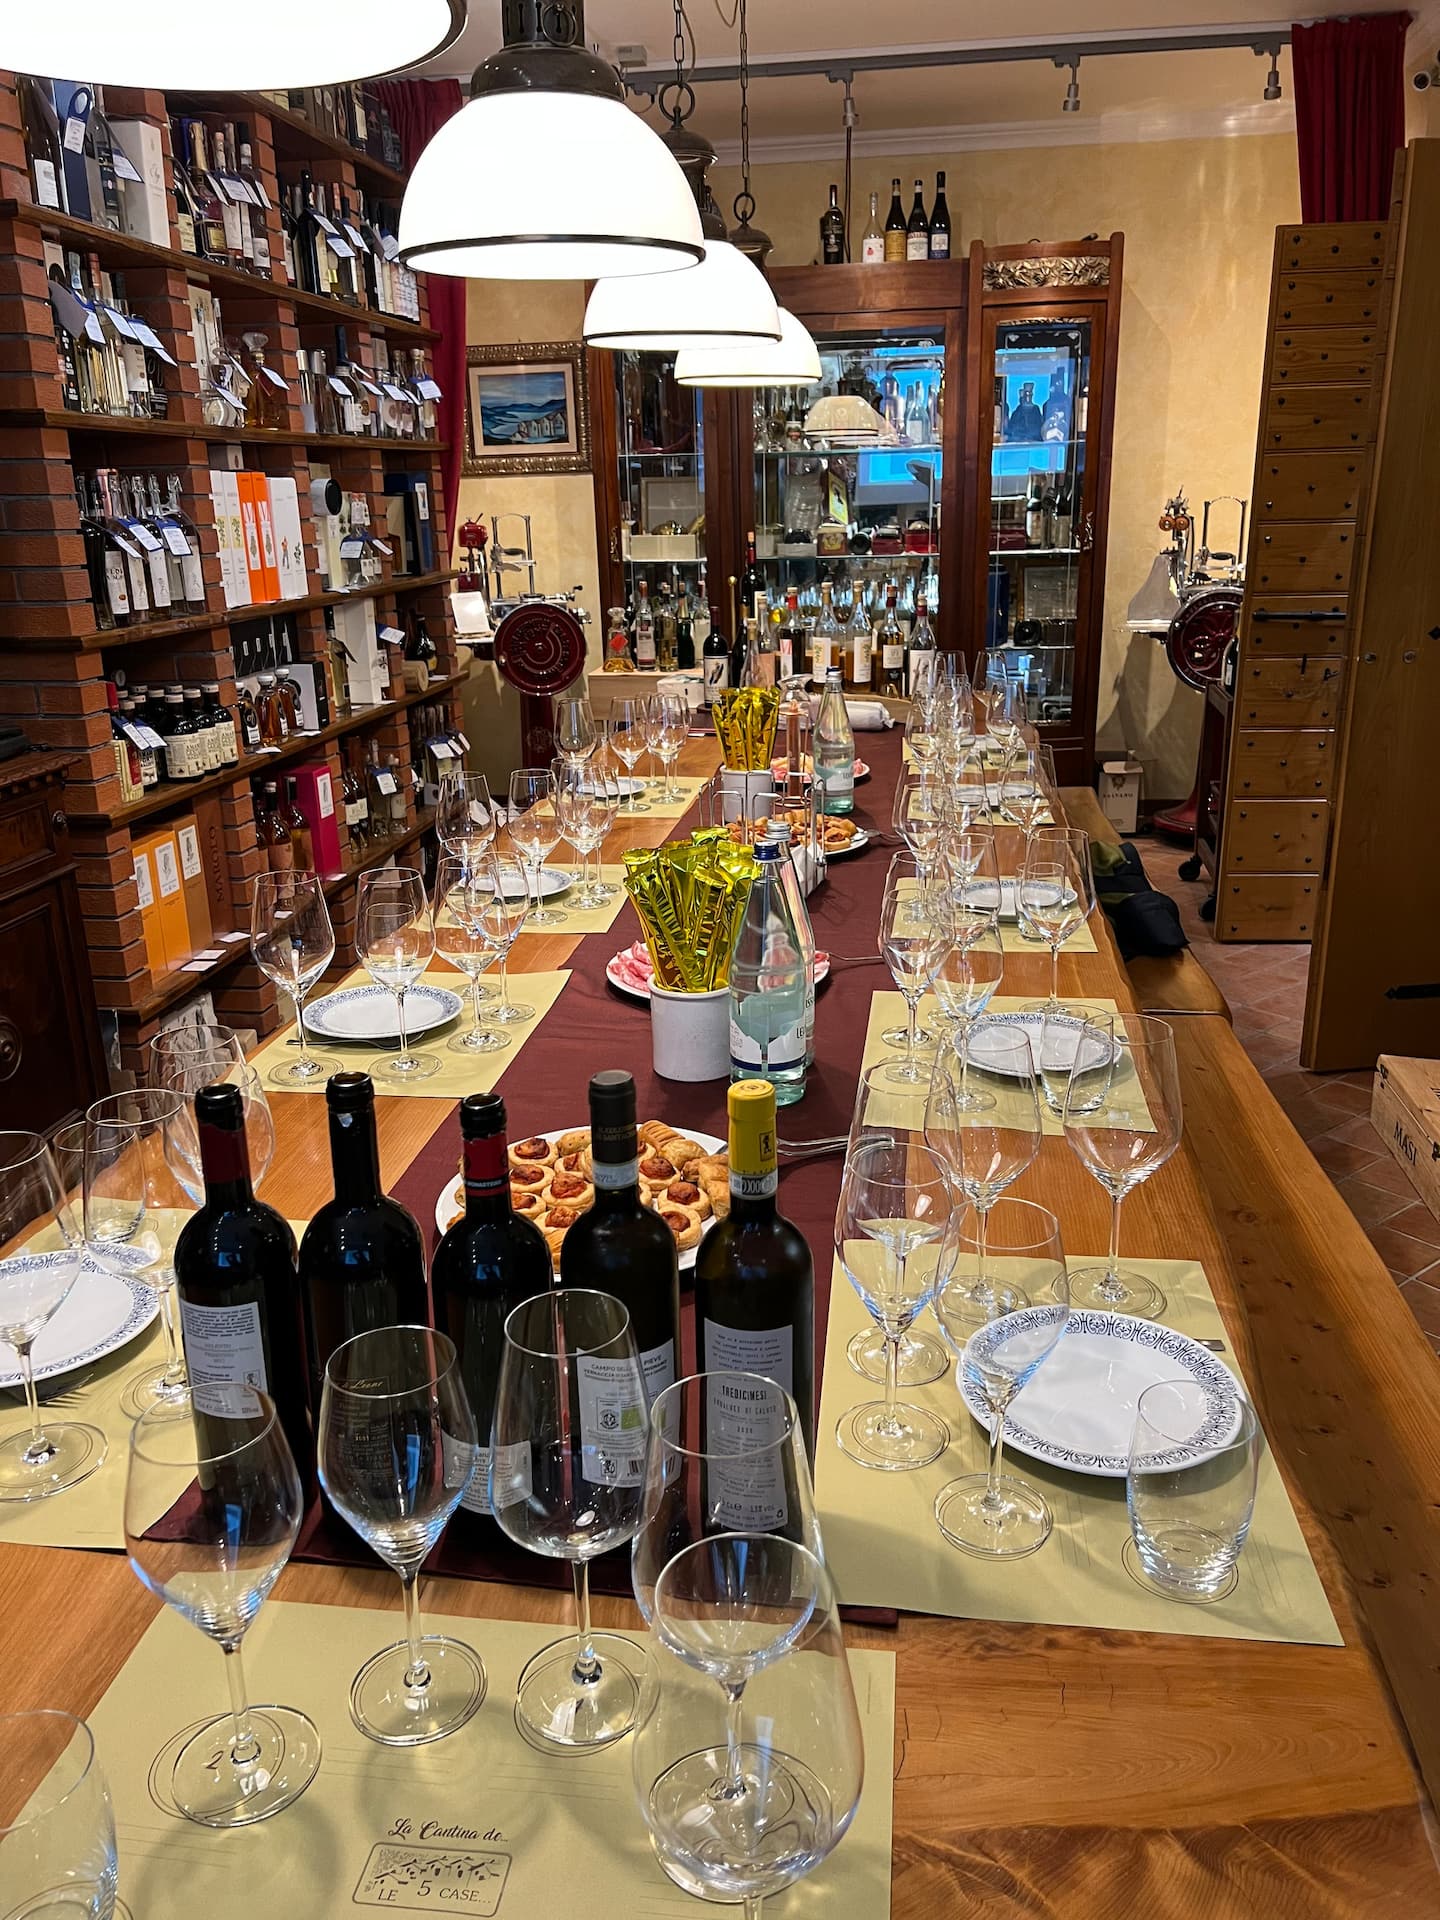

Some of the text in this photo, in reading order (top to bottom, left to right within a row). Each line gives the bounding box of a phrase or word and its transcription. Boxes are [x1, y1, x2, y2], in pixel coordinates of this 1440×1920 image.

[1394, 1119, 1417, 1166] MASI
[388, 1818, 415, 1840] La
[419, 1820, 480, 1841] Cantina
[378, 1888, 399, 1902] LE
[417, 1880, 432, 1896] 5
